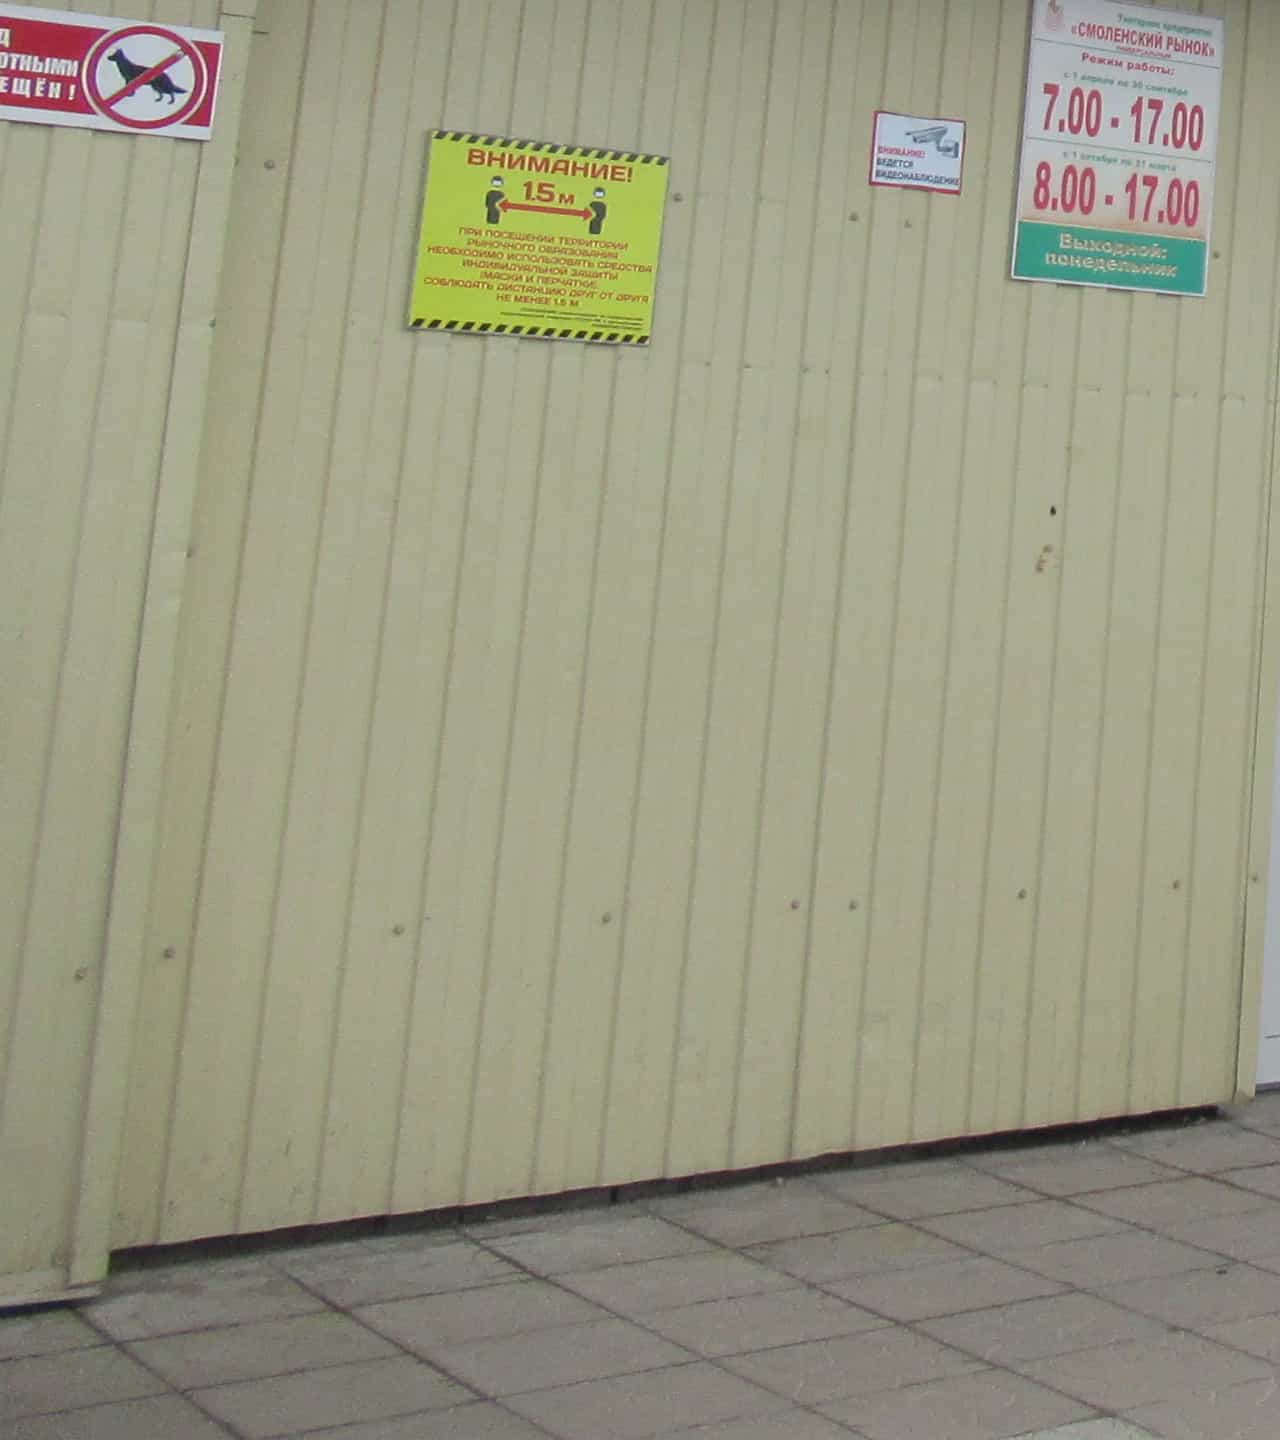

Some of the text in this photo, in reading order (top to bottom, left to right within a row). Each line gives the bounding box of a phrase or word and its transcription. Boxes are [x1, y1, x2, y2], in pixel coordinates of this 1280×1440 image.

[1081, 51, 1123, 68] Режим
[1042, 83, 1102, 137] 7.00
[1130, 95, 1205, 152] 17.00
[466, 148, 633, 183] ВНИМАНИЕ!
[1033, 161, 1096, 216] 8.00
[1125, 173, 1200, 227] 17.00
